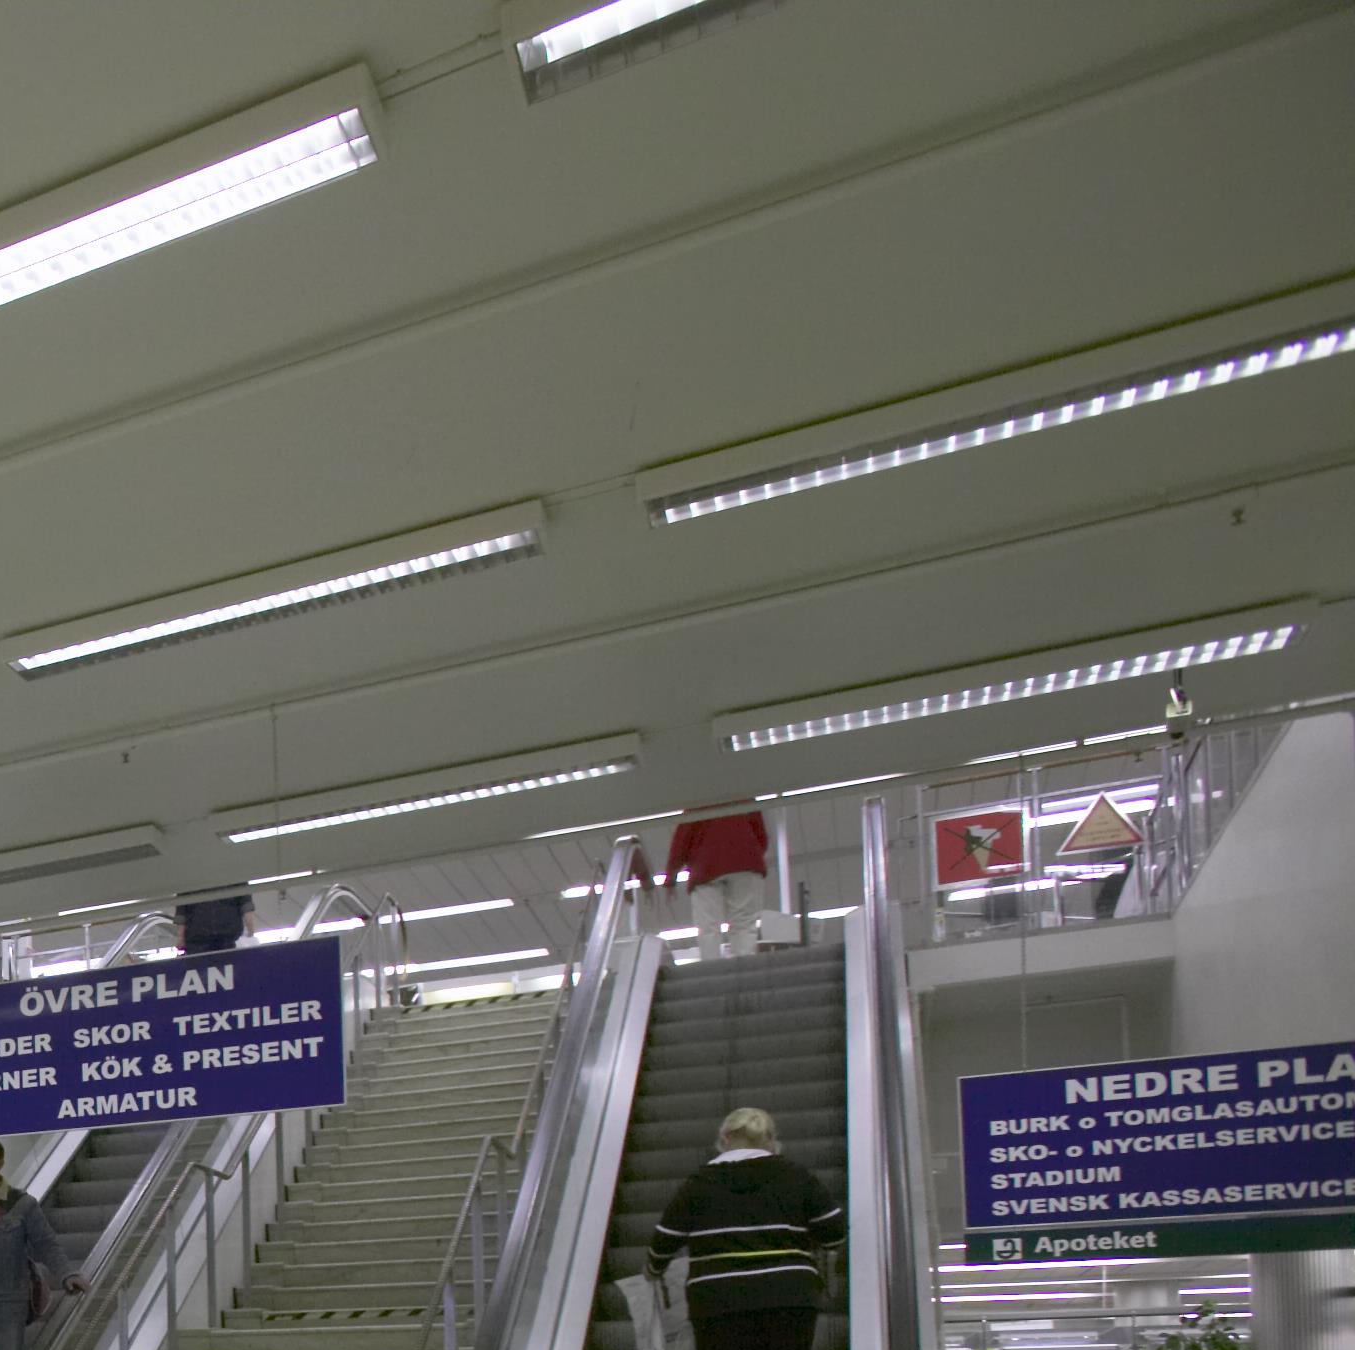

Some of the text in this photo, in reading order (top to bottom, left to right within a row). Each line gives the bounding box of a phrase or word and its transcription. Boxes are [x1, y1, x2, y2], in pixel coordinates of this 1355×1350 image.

[19, 964, 235, 1017] ÖVRE PLAN
[73, 1021, 151, 1048] SKOR
[173, 1000, 323, 1037] TEXTILER
[81, 1056, 142, 1082] KÖK
[152, 1054, 173, 1075] &
[183, 1036, 324, 1072] PRESENT
[1065, 1064, 1239, 1104] NEDRE
[58, 1087, 198, 1120] ARMATUR
[989, 1115, 1070, 1137] BURK
[989, 1144, 1058, 1164] SKO-
[1092, 1121, 1355, 1156] NYCKELSERVICE
[990, 1166, 1122, 1190] STADIUM
[991, 1193, 1109, 1217] SVENSK
[1034, 1231, 1158, 1257] Apoteket
